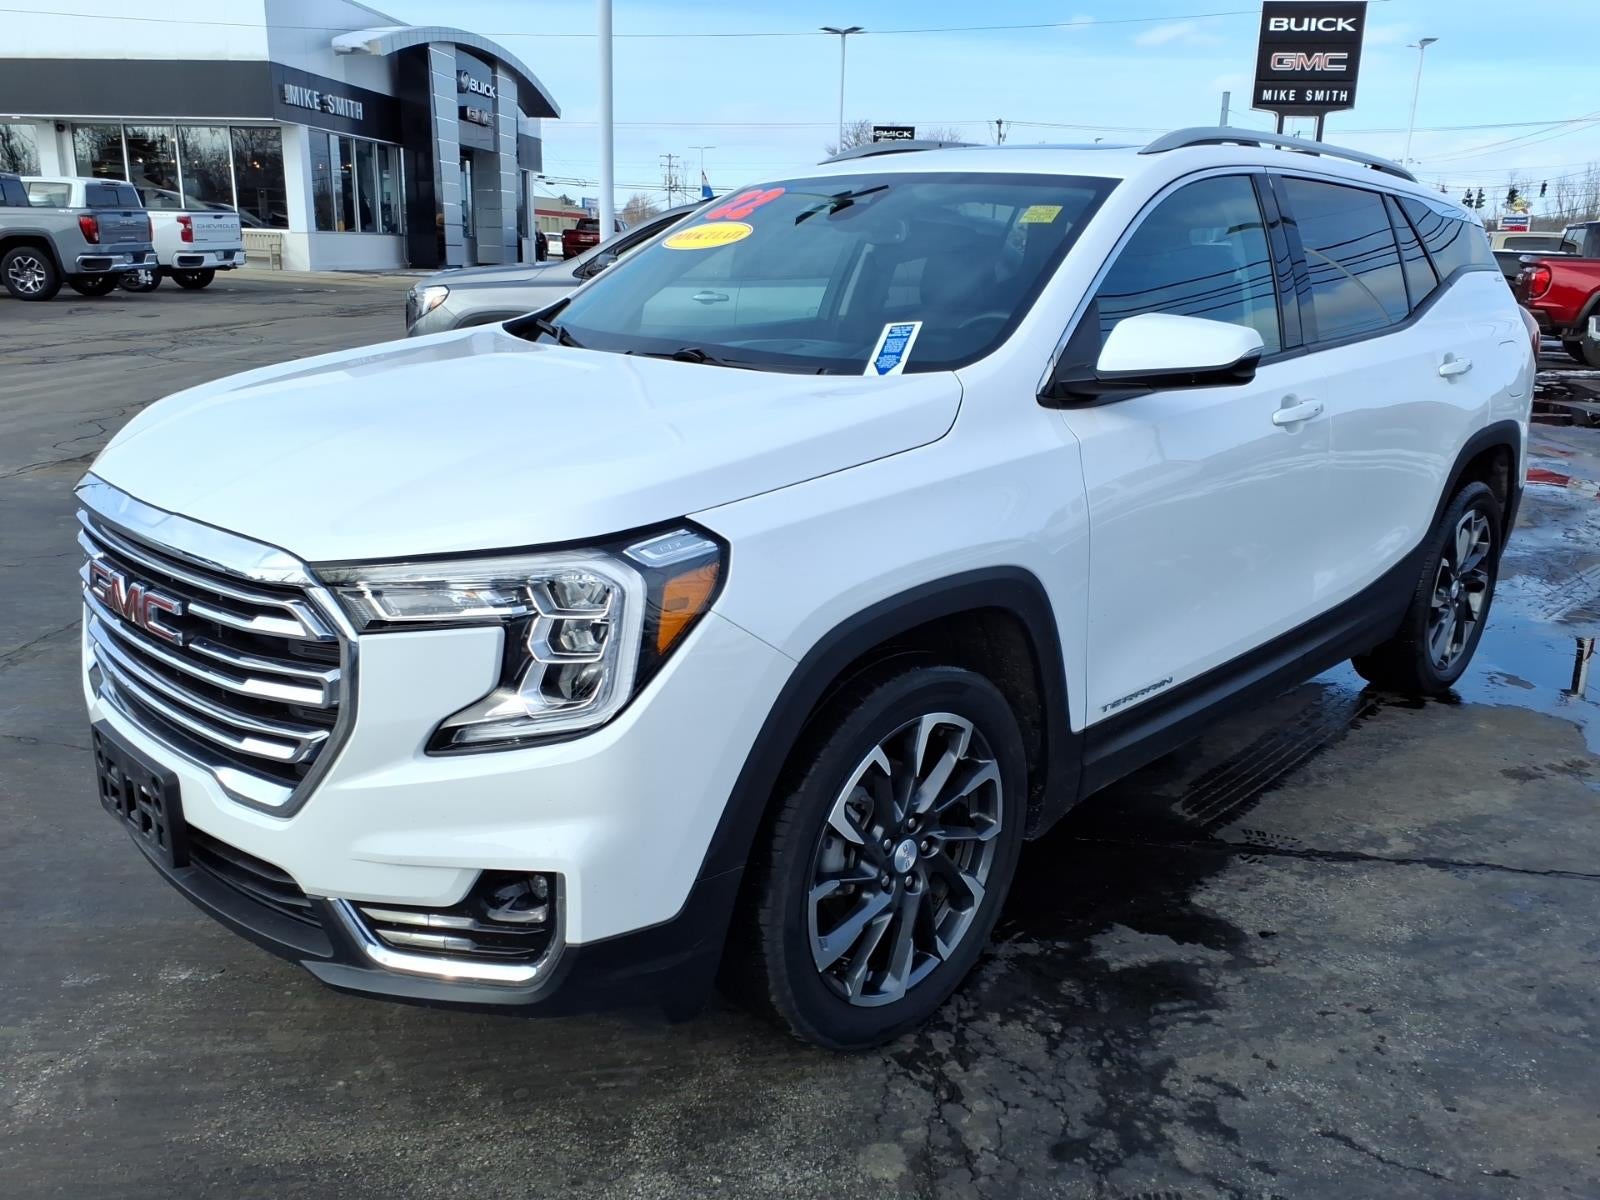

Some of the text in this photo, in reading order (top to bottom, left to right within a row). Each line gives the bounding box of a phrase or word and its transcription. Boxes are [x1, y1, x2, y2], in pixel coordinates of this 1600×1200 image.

[1269, 17, 1357, 31] BUICK
[1270, 52, 1348, 71] GMC
[470, 78, 496, 98] BUICK
[1262, 89, 1348, 102] MIKE SMITH
[285, 84, 363, 120] MIKE SMITH
[82, 560, 182, 646] GMC
[1101, 676, 1173, 712] TERRAIN
